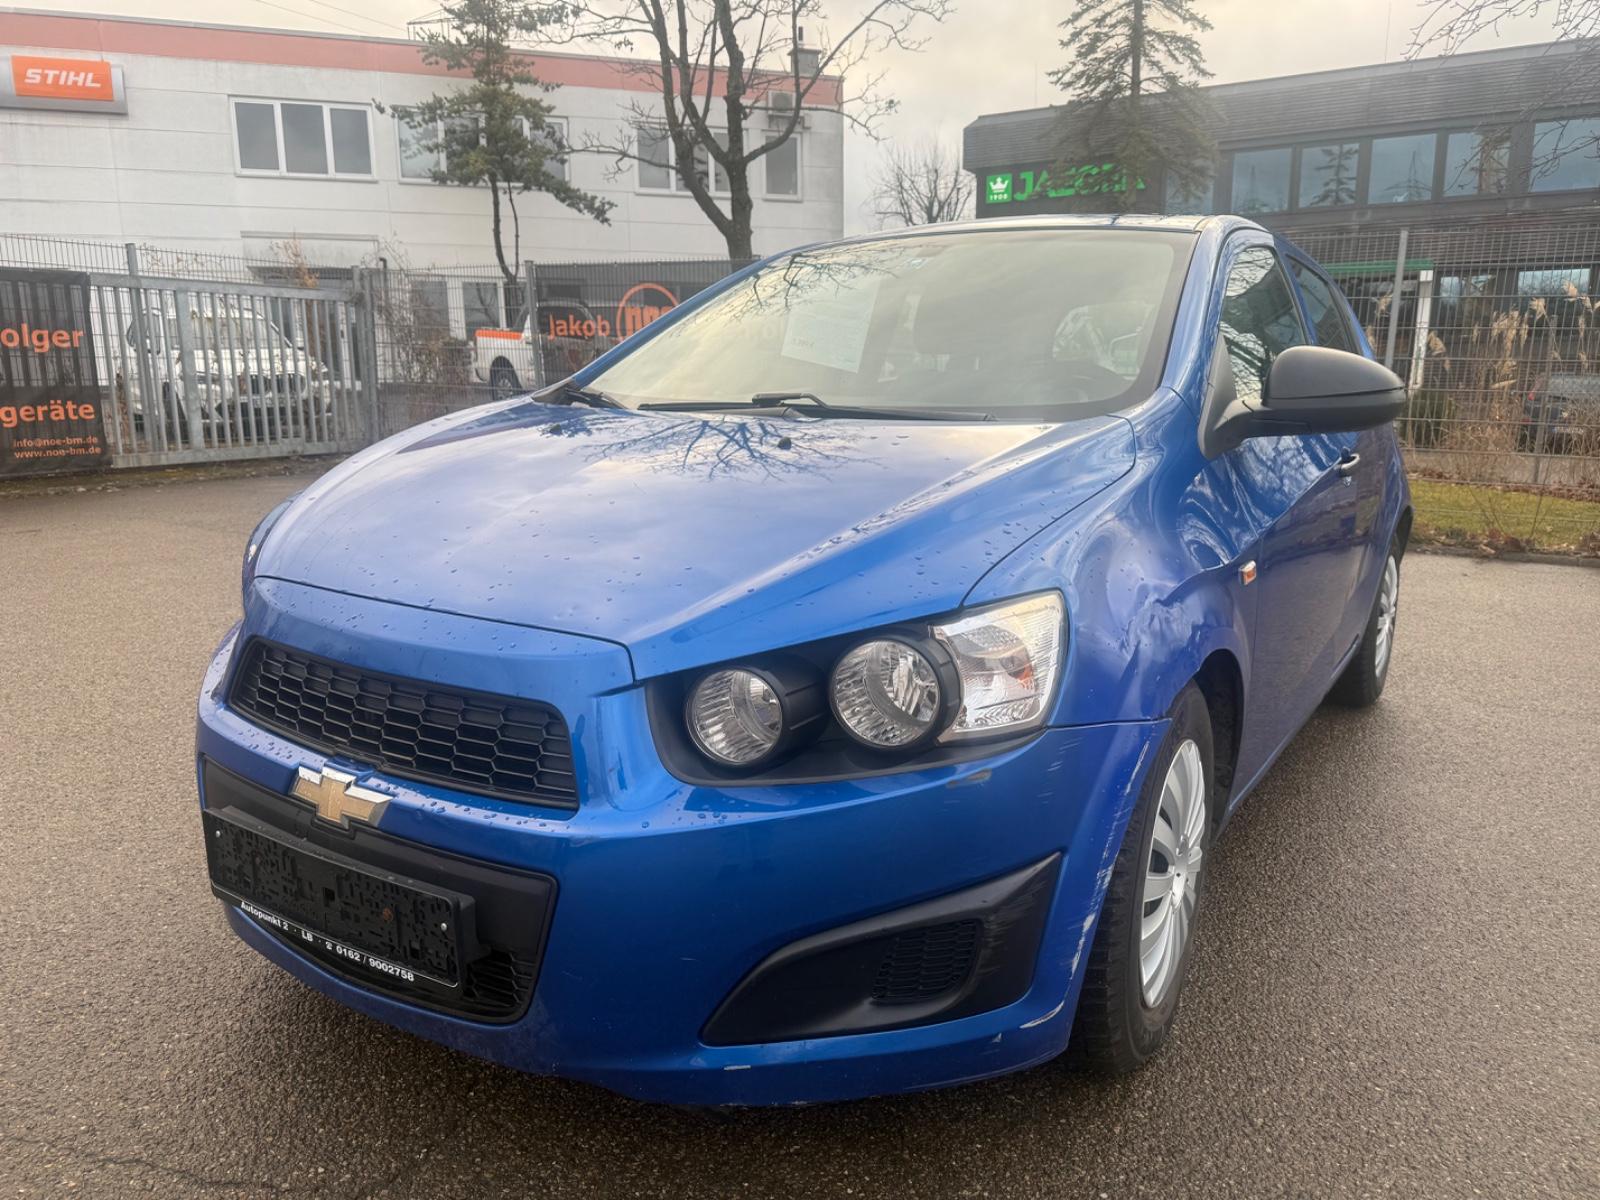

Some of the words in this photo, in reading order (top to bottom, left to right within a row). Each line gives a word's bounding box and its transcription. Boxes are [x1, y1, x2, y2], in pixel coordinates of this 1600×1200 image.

[24, 67, 102, 88] STIHL
[547, 313, 611, 341] Jakob
[14, 446, 102, 459] www.noe-bm.de
[240, 901, 282, 928] Autopunkt
[336, 945, 361, 961] 0162
